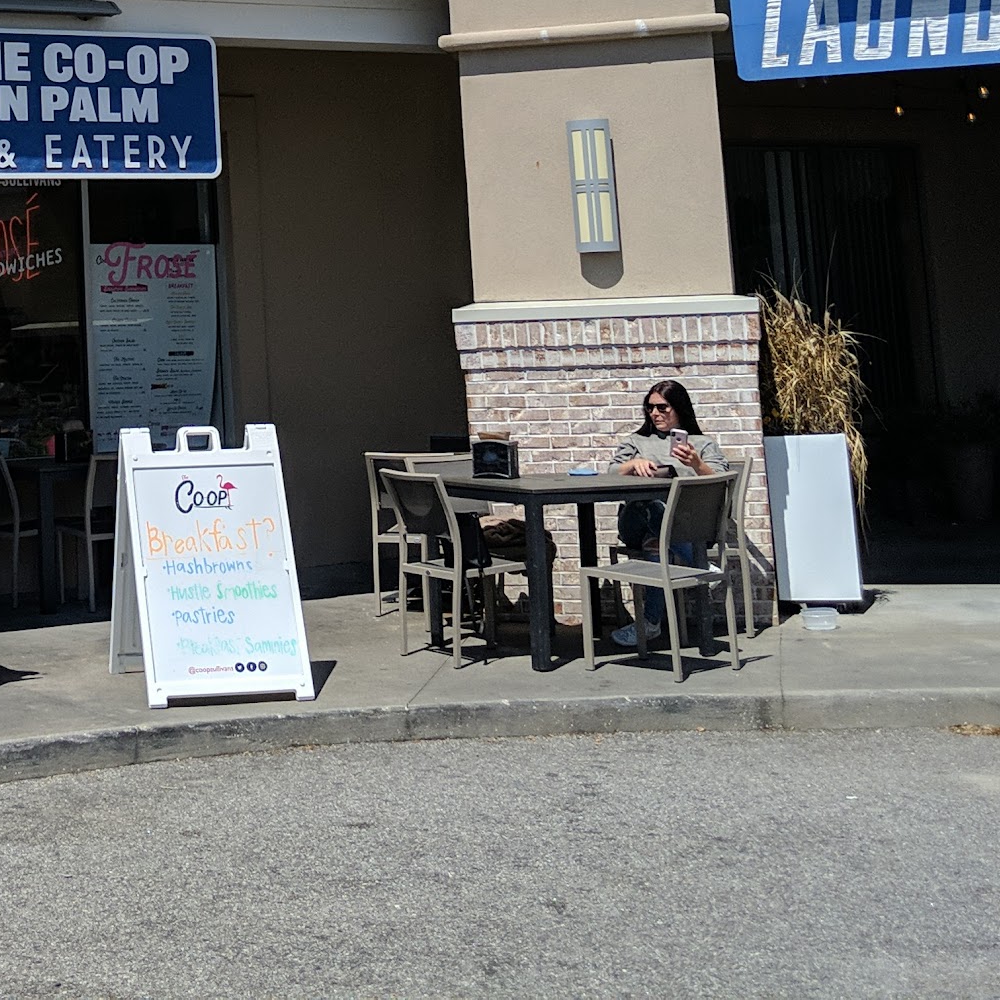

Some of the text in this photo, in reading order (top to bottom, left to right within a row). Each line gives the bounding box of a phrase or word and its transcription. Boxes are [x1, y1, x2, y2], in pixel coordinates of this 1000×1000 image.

[43, 43, 190, 85] CO-OP
[41, 86, 159, 123] PALM
[45, 134, 192, 170] EATERY
[216, 580, 278, 600] Smoothies
[188, 665, 234, 675] @coopsullivans
